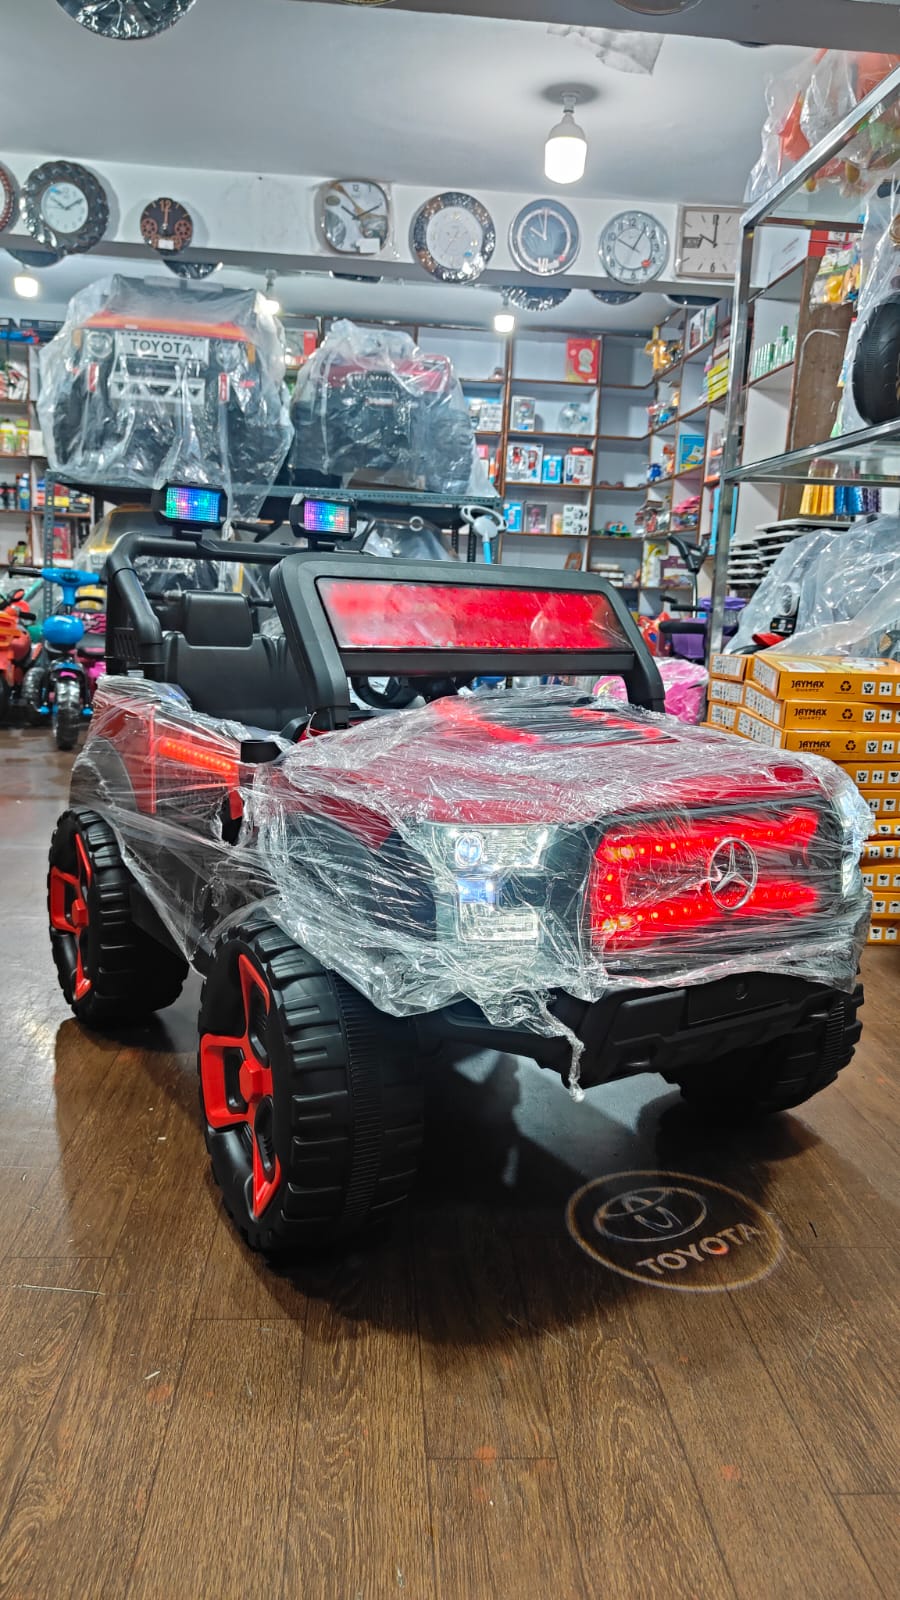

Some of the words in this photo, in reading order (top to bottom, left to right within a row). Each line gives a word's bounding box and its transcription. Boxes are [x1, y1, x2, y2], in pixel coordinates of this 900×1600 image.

[130, 339, 193, 355] TOYOTA
[791, 680, 825, 689] JAYMAX
[794, 708, 827, 717] JAYMAX
[798, 740, 831, 749] JAYMAX
[636, 1223, 761, 1275] TOYOTA
